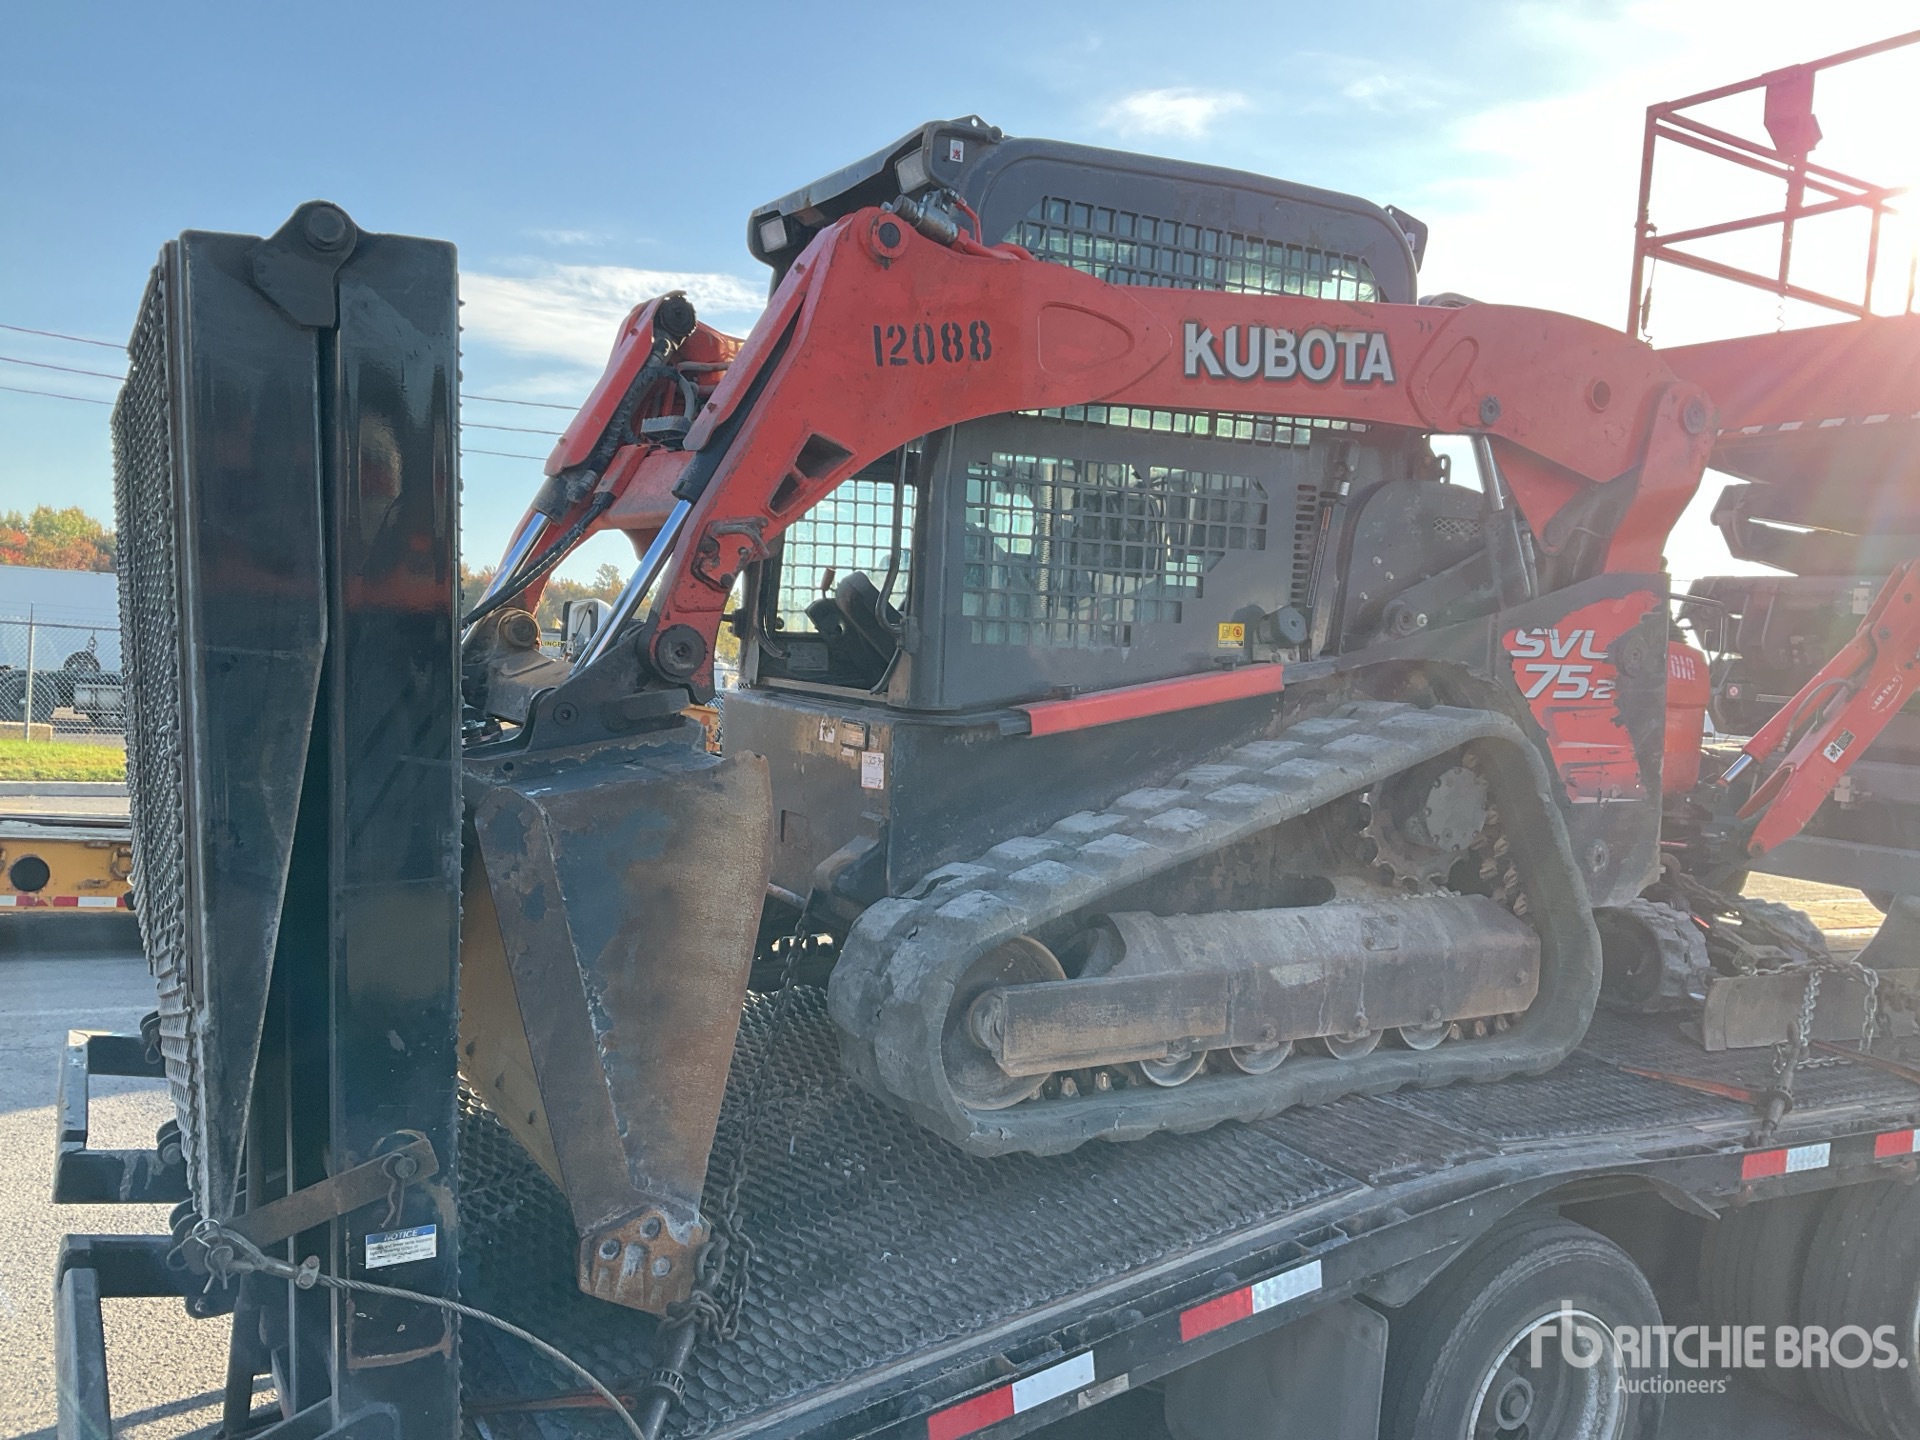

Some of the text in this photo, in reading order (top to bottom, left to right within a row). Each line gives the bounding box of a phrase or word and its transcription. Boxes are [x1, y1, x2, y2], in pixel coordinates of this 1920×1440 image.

[872, 320, 992, 367] 12088
[1184, 320, 1395, 383] KUBOTA
[1510, 628, 1609, 659] SVL
[384, 1229, 418, 1241] NOTICE
